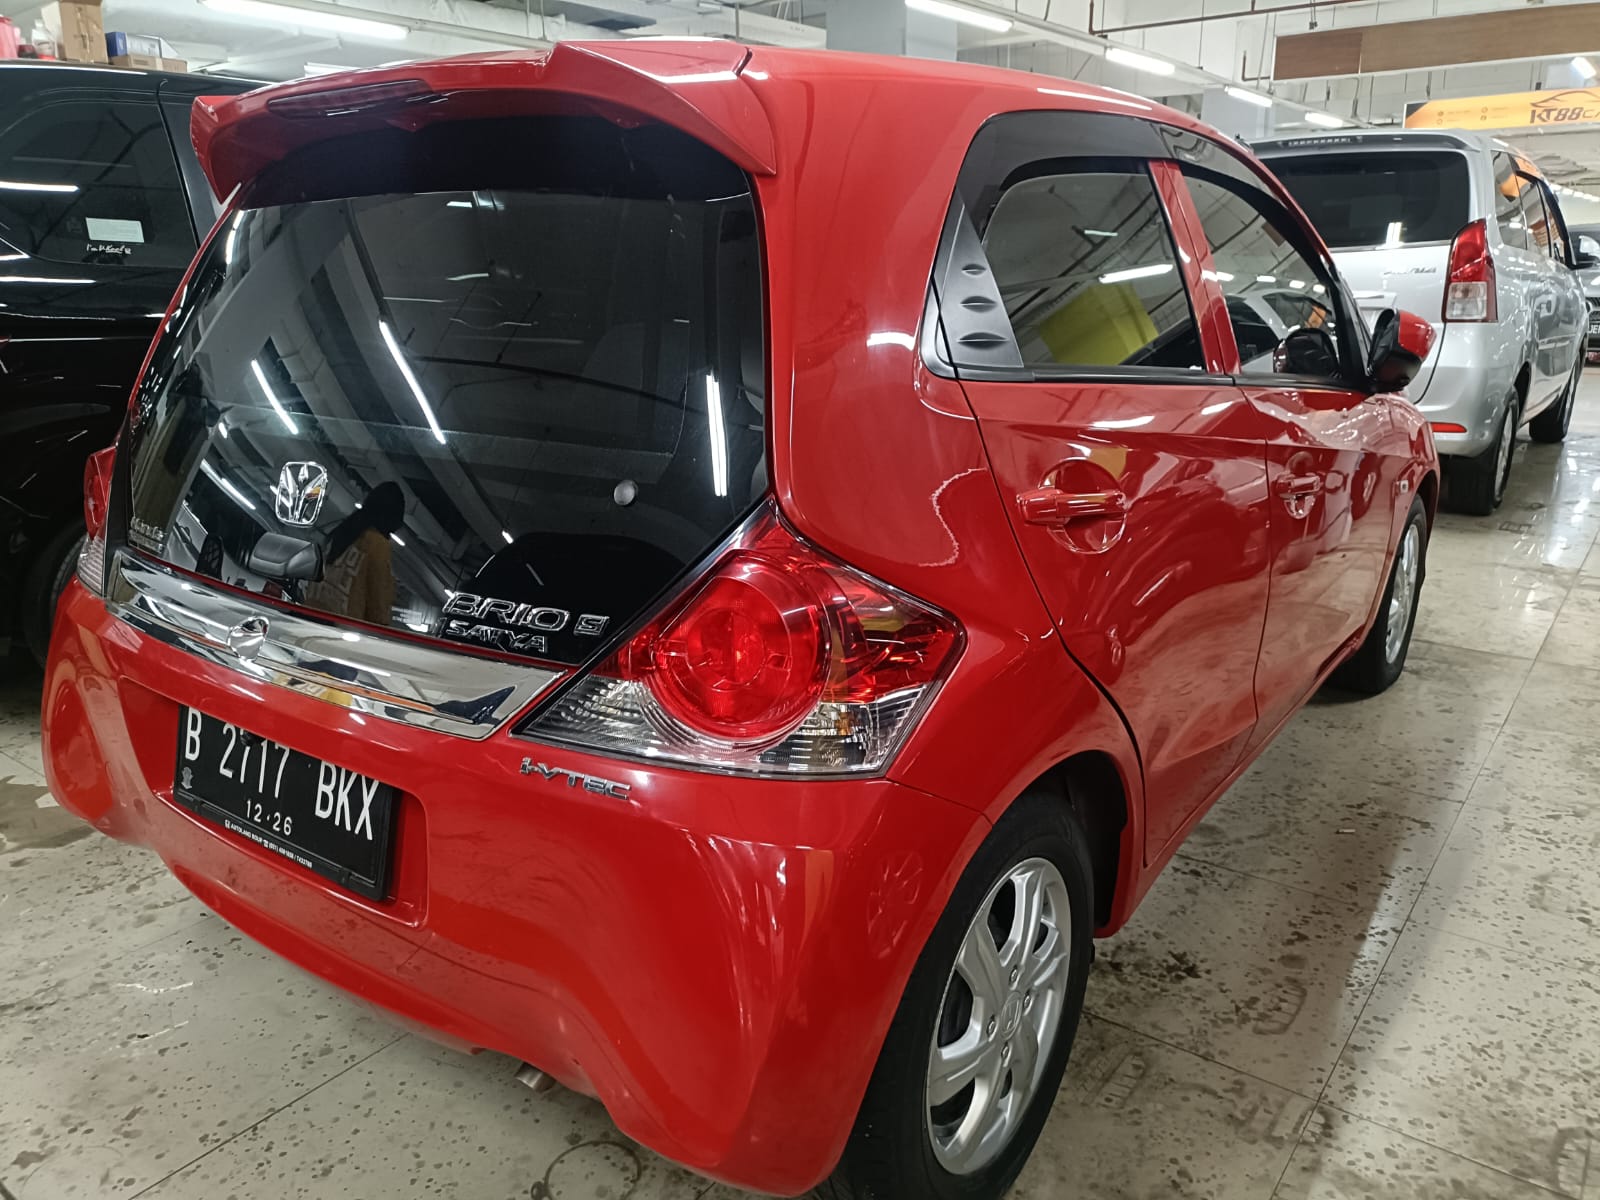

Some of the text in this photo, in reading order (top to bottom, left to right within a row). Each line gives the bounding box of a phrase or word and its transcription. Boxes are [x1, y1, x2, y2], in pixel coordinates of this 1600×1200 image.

[441, 591, 570, 632] BRIO
[445, 619, 548, 652] SATYA
[185, 706, 380, 841] B 2717 BKX
